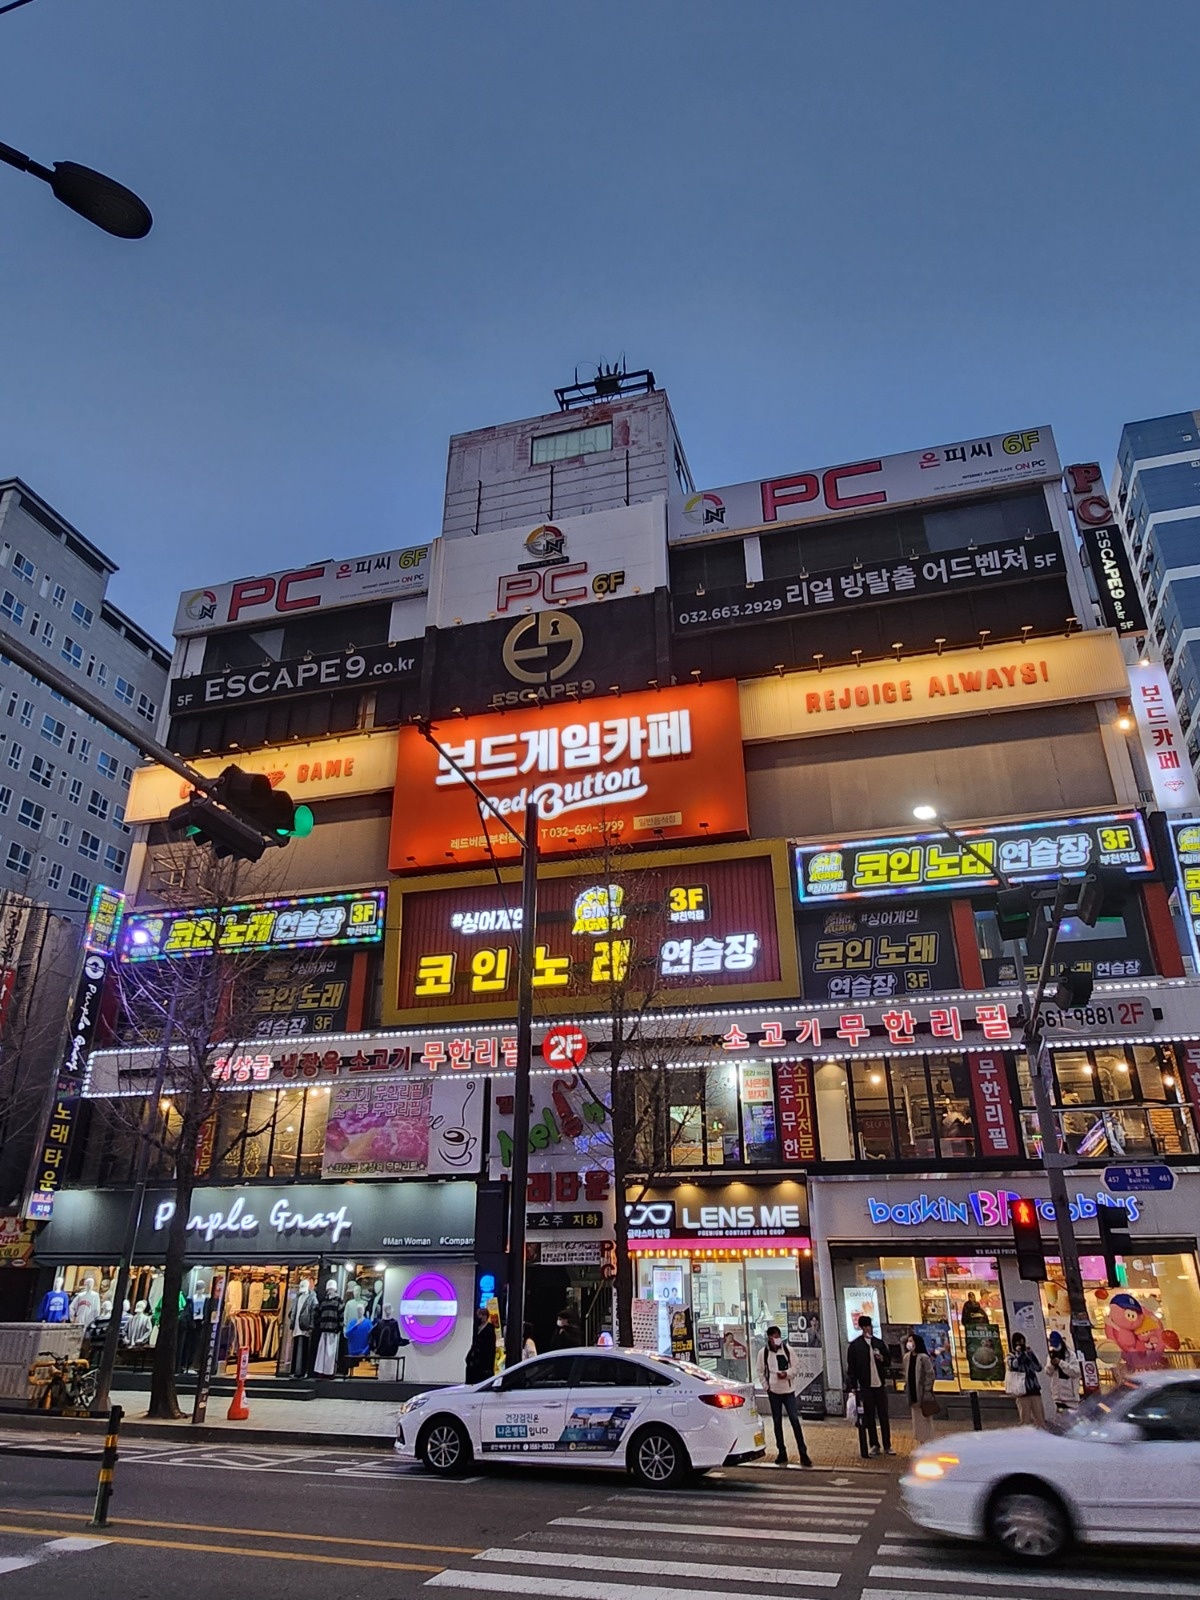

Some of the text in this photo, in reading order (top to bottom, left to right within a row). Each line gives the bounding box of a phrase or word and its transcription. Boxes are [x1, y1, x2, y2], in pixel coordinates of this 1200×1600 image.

[1002, 430, 1039, 455] 6F
[1015, 463, 1030, 471] ON
[1031, 460, 1046, 468] PC
[760, 460, 888, 522] PC
[1069, 464, 1112, 525] PC
[399, 547, 428, 569] 6F
[227, 567, 325, 622] PC
[497, 561, 587, 612] PC
[592, 571, 625, 594] 6F
[679, 598, 783, 625] 032.663.2929
[786, 578, 835, 607] 리얼
[840, 565, 917, 599] 방탈출
[1034, 553, 1058, 569] 5F
[1120, 620, 1135, 631] 5F
[176, 694, 194, 707] 5F
[806, 661, 1050, 714] REJOICE ALWAYS!
[1141, 684, 1182, 771] 보드카페
[435, 709, 692, 787] 보드게임카페
[297, 757, 354, 783] GAME
[479, 766, 648, 821] Red Button
[541, 828, 548, 839] T
[1101, 829, 1130, 850] 3F
[815, 863, 839, 872] SING
[855, 833, 1090, 886] 코인 노래 연습장
[1100, 851, 1141, 865] 부천역점
[668, 887, 704, 912] 3F
[352, 902, 375, 924] 3F
[861, 909, 919, 926] #싱어게인
[164, 918, 217, 951] 코인
[218, 911, 277, 944] 노래
[273, 908, 346, 942] 연습장
[660, 932, 760, 975] 연습장
[815, 934, 937, 970] 코인 노래
[1097, 959, 1141, 976] 연습장
[298, 981, 346, 1010] 노래
[829, 972, 929, 1000] 연습장 3F
[78, 983, 98, 1031] Purple
[1118, 1002, 1144, 1026] 2F
[256, 1015, 332, 1038] 연습장 3F
[550, 1033, 583, 1061] 2F
[211, 1055, 273, 1081] 최상급
[280, 1049, 341, 1078] 냉장육
[348, 1046, 412, 1073] 소고기
[336, 1083, 425, 1101] 소고기 무한리필
[745, 1078, 770, 1088] 사은품
[372, 1101, 422, 1117] 무한리필
[793, 1062, 815, 1159] 소고기전문
[978, 1059, 1009, 1150] 무한리필
[40, 1102, 73, 1193] 노래타운
[1125, 1167, 1151, 1177] 부일로
[526, 1170, 610, 1202] 래타운
[154, 1197, 353, 1243] Prple Gray
[572, 1214, 598, 1227] 지하
[683, 1205, 800, 1229] LENS ME
[868, 1194, 969, 1226] baskin
[403, 1237, 431, 1246] Woman
[528, 1425, 549, 1437] 입니다
